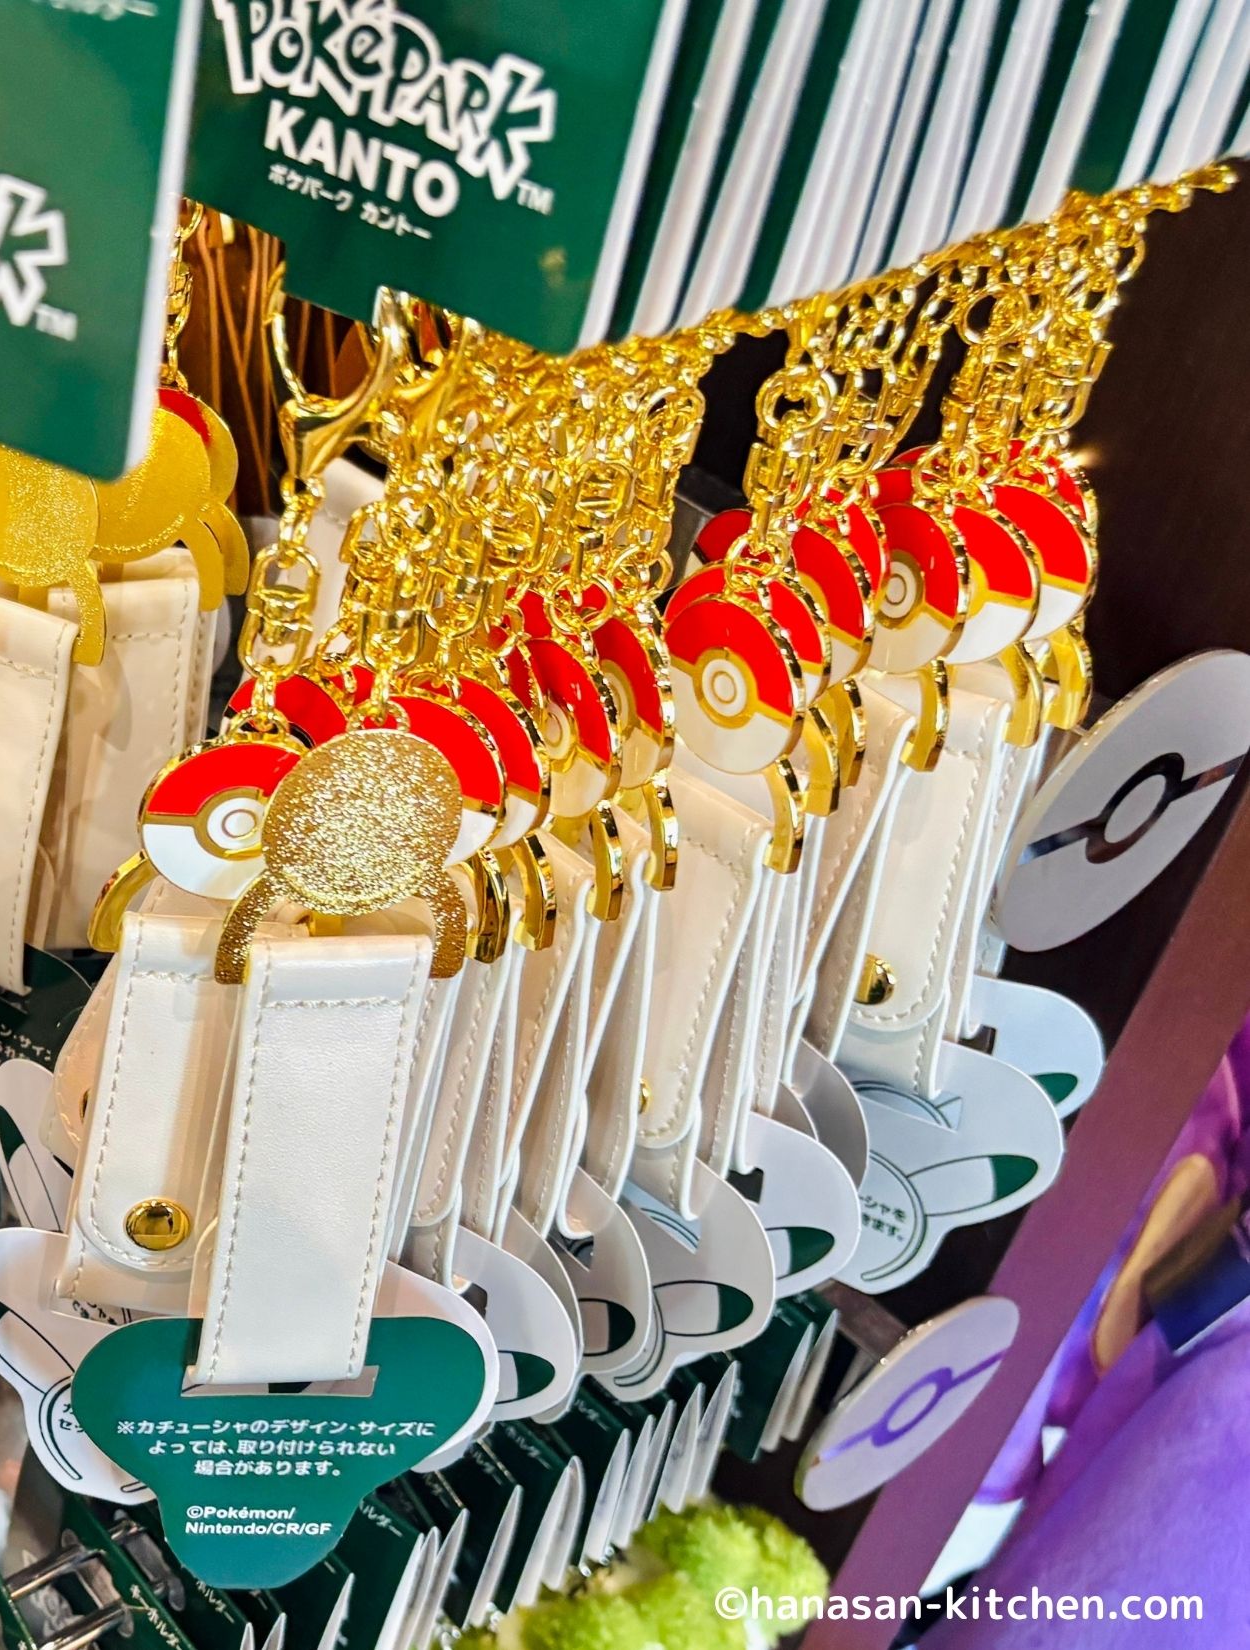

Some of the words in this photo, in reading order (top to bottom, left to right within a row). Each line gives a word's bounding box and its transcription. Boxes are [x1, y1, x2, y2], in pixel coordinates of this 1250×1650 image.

[264, 99, 460, 218] KANTO
[268, 163, 354, 211] ポケパーク
[360, 201, 432, 240] カントー
[148, 1439, 396, 1456] よっては、取り付けられない
[194, 1460, 342, 1477] 場合があります。
[187, 1505, 296, 1520] ©Pokémon/
[185, 1522, 332, 1536] Nintendo/CR/GF
